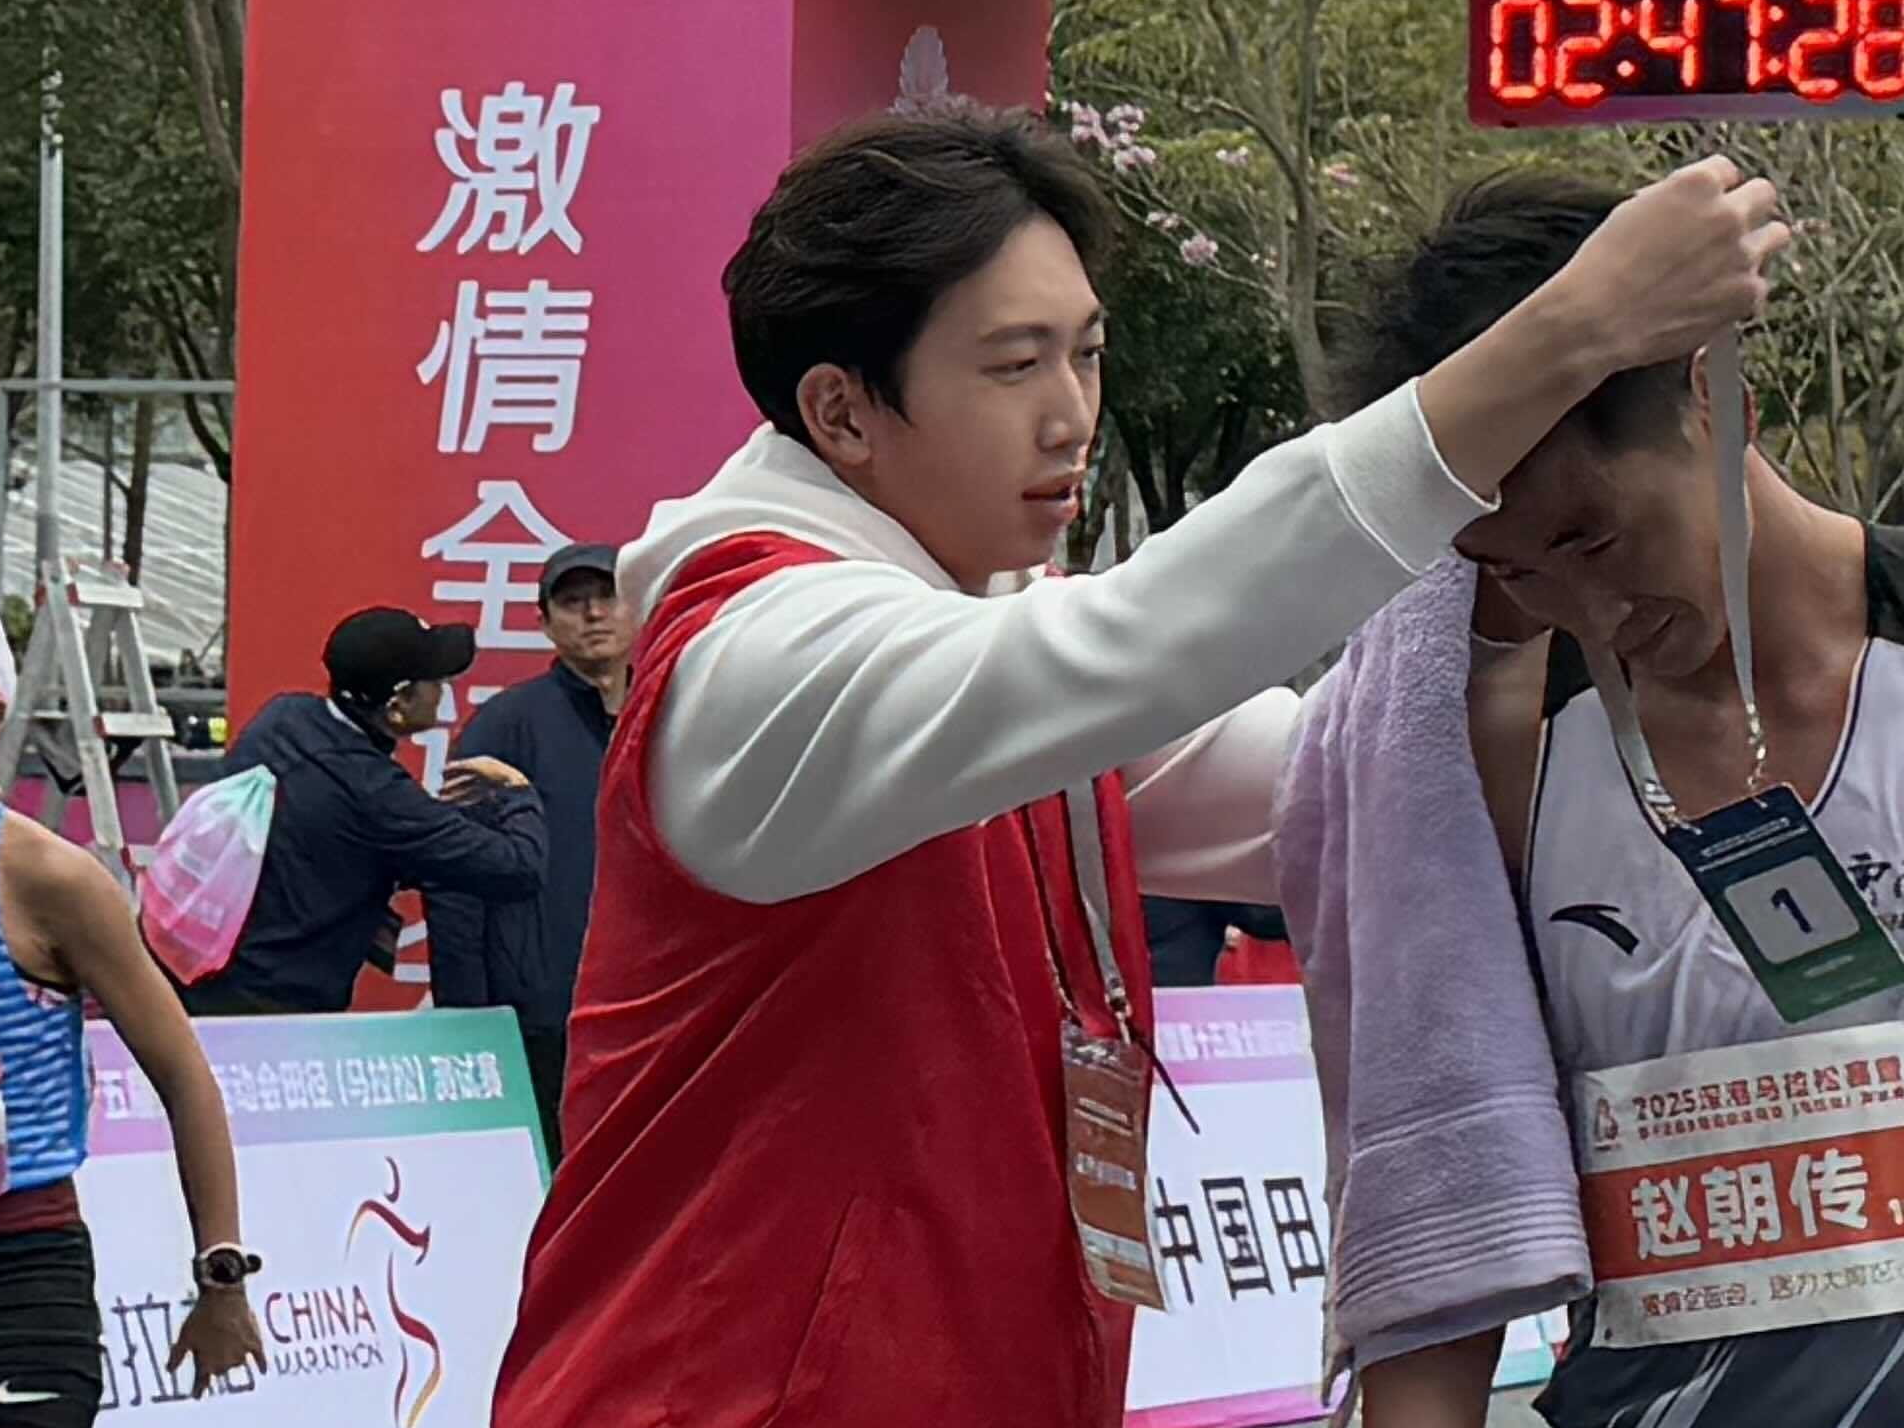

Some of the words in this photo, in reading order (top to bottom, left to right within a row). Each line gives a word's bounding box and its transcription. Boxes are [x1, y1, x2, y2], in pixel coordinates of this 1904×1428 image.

[1771, 887, 1813, 934] 1
[1630, 1148, 1869, 1261] 赵朝传
[264, 1284, 377, 1344] CHINA
